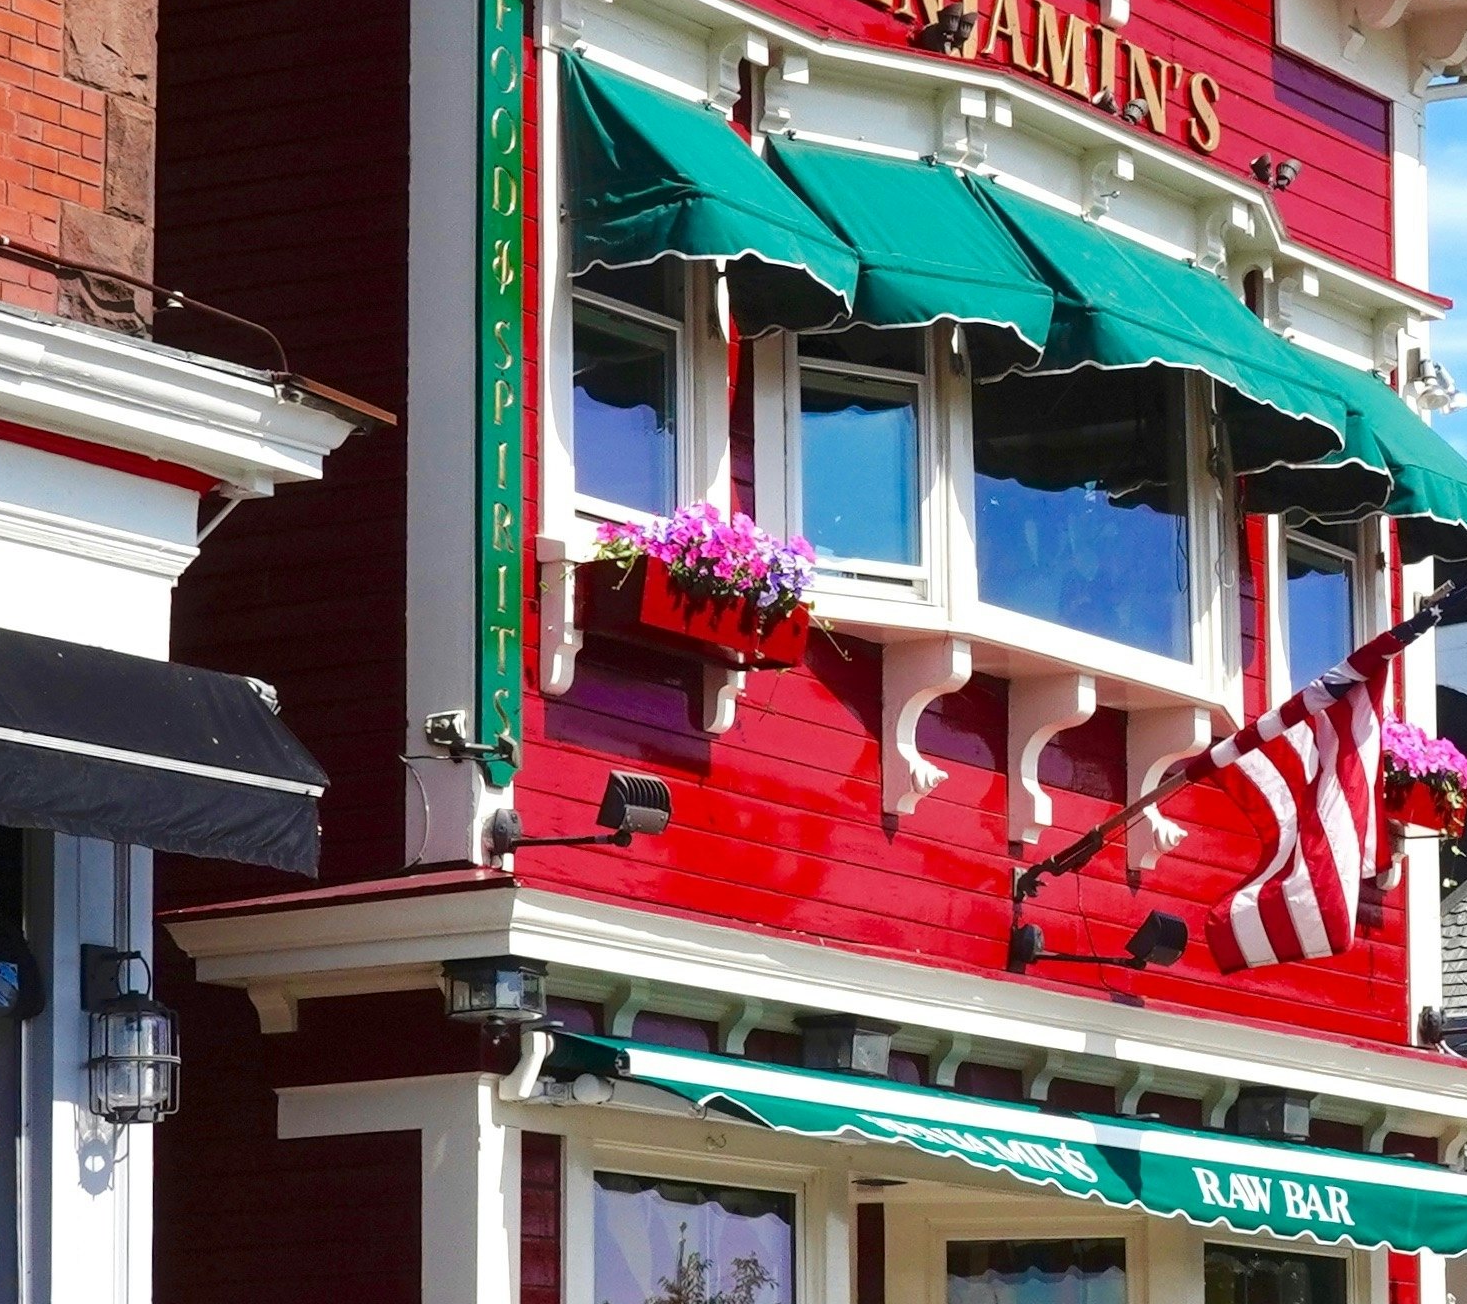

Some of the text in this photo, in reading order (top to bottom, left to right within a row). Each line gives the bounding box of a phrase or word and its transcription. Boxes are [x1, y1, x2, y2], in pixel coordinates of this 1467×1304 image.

[490, 320, 516, 738] SPIRITS
[1191, 1166, 1356, 1226] RAW BAR
